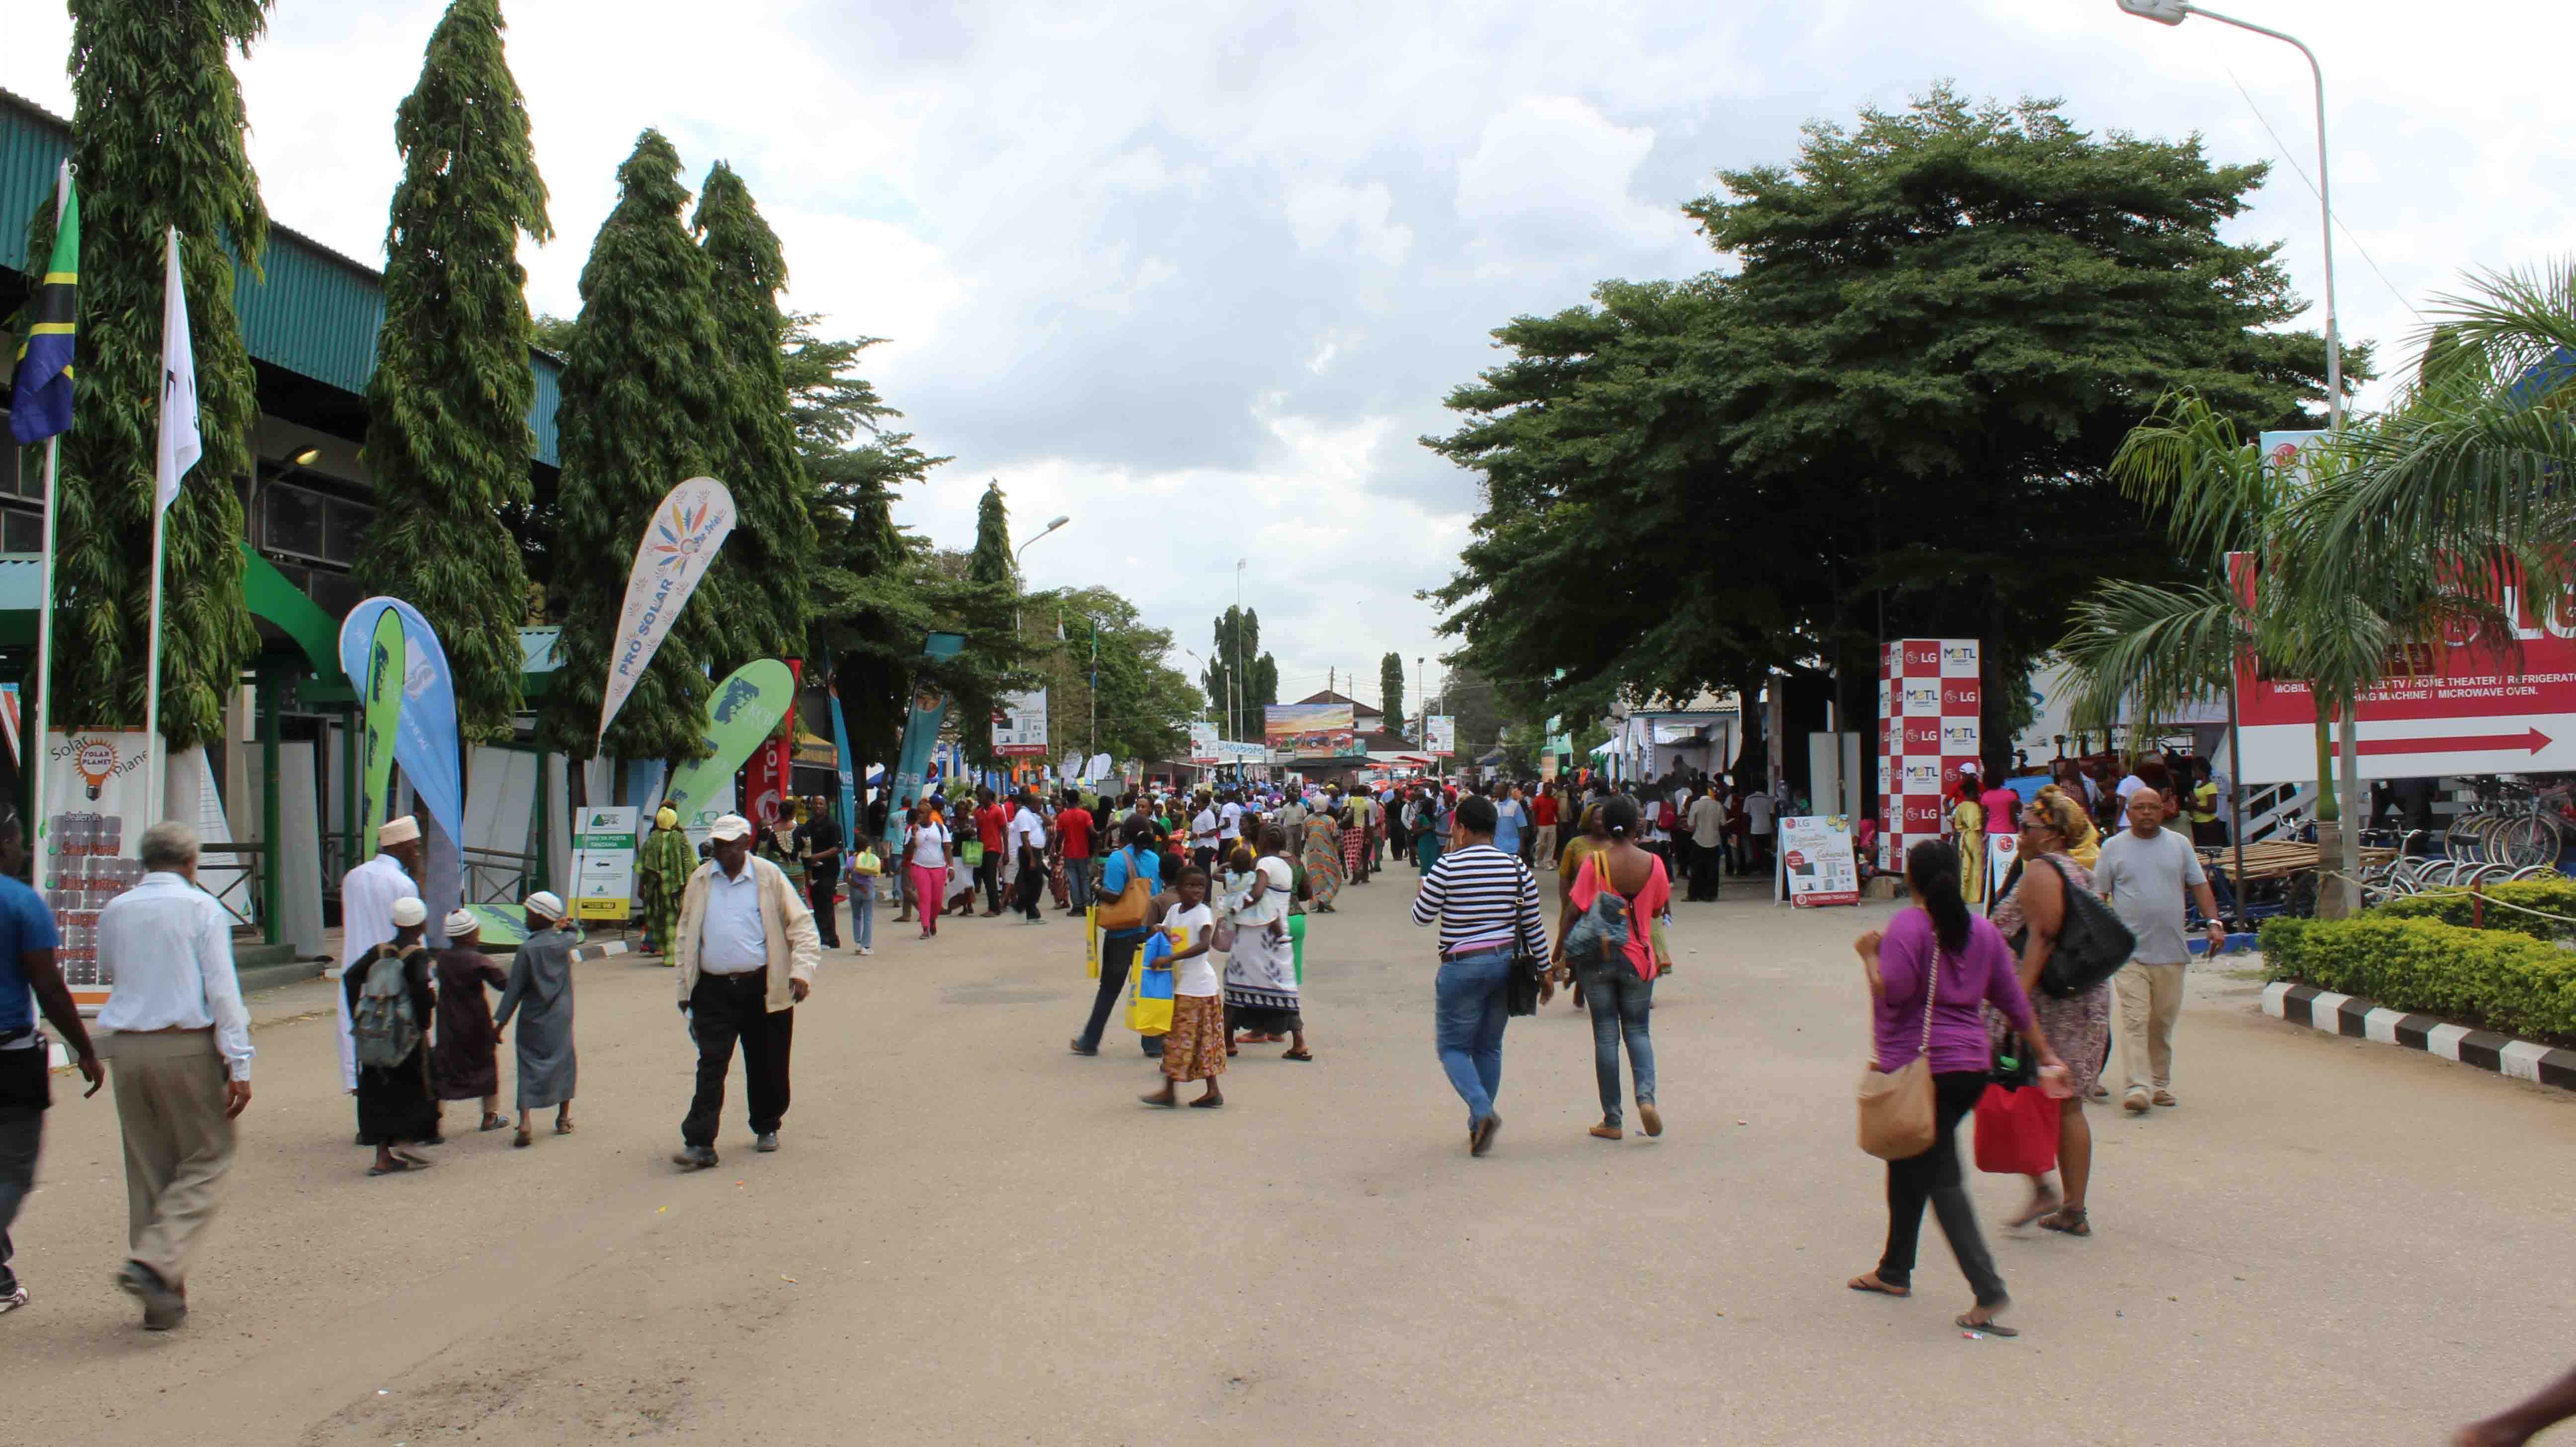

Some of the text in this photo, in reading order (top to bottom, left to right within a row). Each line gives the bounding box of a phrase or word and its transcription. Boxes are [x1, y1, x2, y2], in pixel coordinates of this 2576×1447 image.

[619, 578, 673, 675] PRO SOLAR
[1921, 652, 1937, 663] LG
[2393, 679, 2406, 688] TV
[2448, 675, 2496, 686] THEATER
[2274, 683, 2311, 693] MOBIL
[2378, 690, 2427, 701] MACHINE
[2438, 687, 2503, 698] MICROWAVE
[1959, 692, 1976, 702] LG
[1921, 730, 1937, 741] LG
[51, 735, 87, 761] Solar
[1225, 743, 1263, 755] Kubota
[114, 750, 147, 778] Plane
[896, 772, 920, 784] FNB
[1921, 808, 1937, 819] LG
[1797, 819, 1810, 827] LG
[63, 842, 120, 856] Solar Panel
[60, 876, 128, 893] Solar Battery
